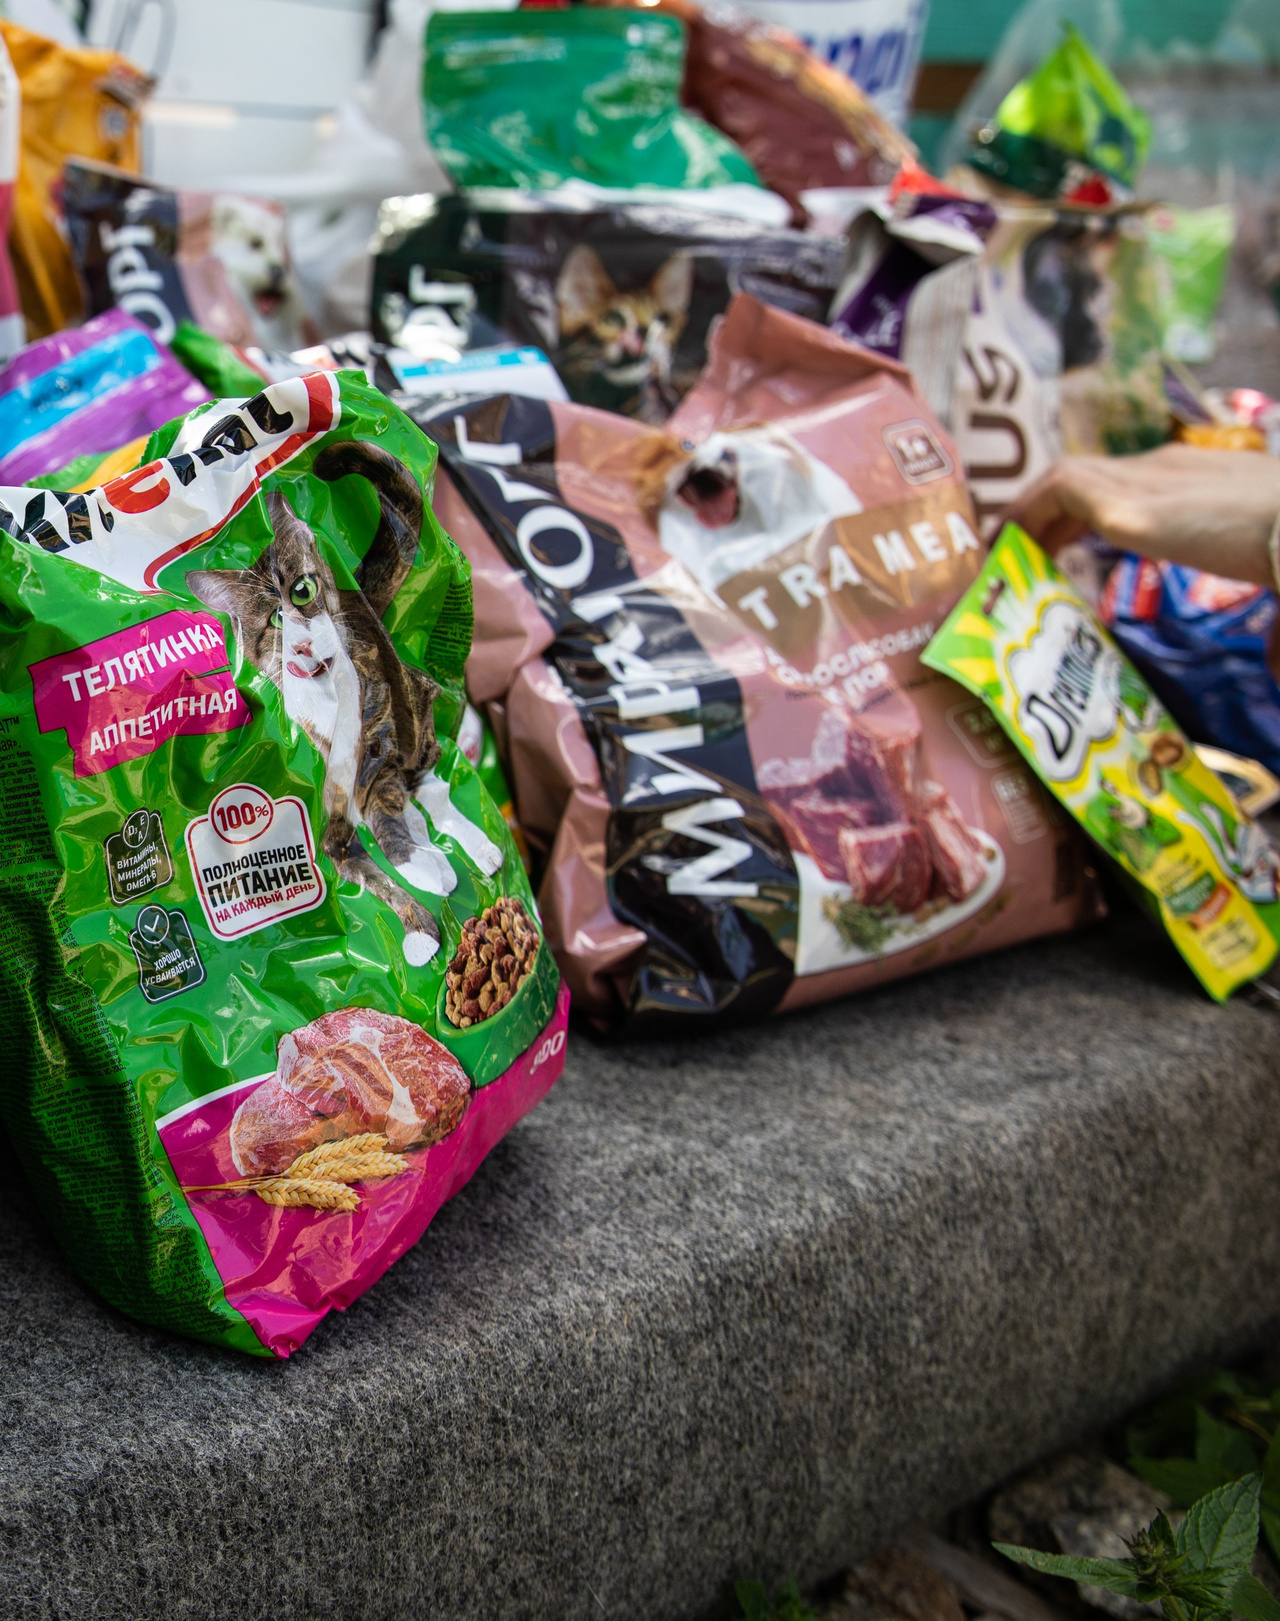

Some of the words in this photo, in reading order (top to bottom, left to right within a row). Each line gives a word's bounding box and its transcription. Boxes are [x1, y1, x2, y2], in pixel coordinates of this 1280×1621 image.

[872, 511, 980, 576] MEA
[61, 623, 224, 702] ТЕЛЯТИНКА
[89, 688, 238, 757] АППЕТИТНАЯ
[216, 801, 271, 832] 100%
[116, 841, 159, 871] ВИТАМИНЫ,
[117, 854, 162, 883] МИНЕРАЛЫ,
[202, 844, 307, 884] ПОЛНОЦЕННОЕ
[126, 871, 157, 892] ОМЕГА-6
[207, 862, 313, 909] ПИТАНИЕ
[215, 908, 232, 924] НА
[231, 890, 284, 917] КАЖДЫЙ
[285, 882, 316, 902] ДЕНЬ
[144, 956, 197, 987] УСВАИВАЕТСЯ
[153, 948, 182, 972] ХОРОШО
